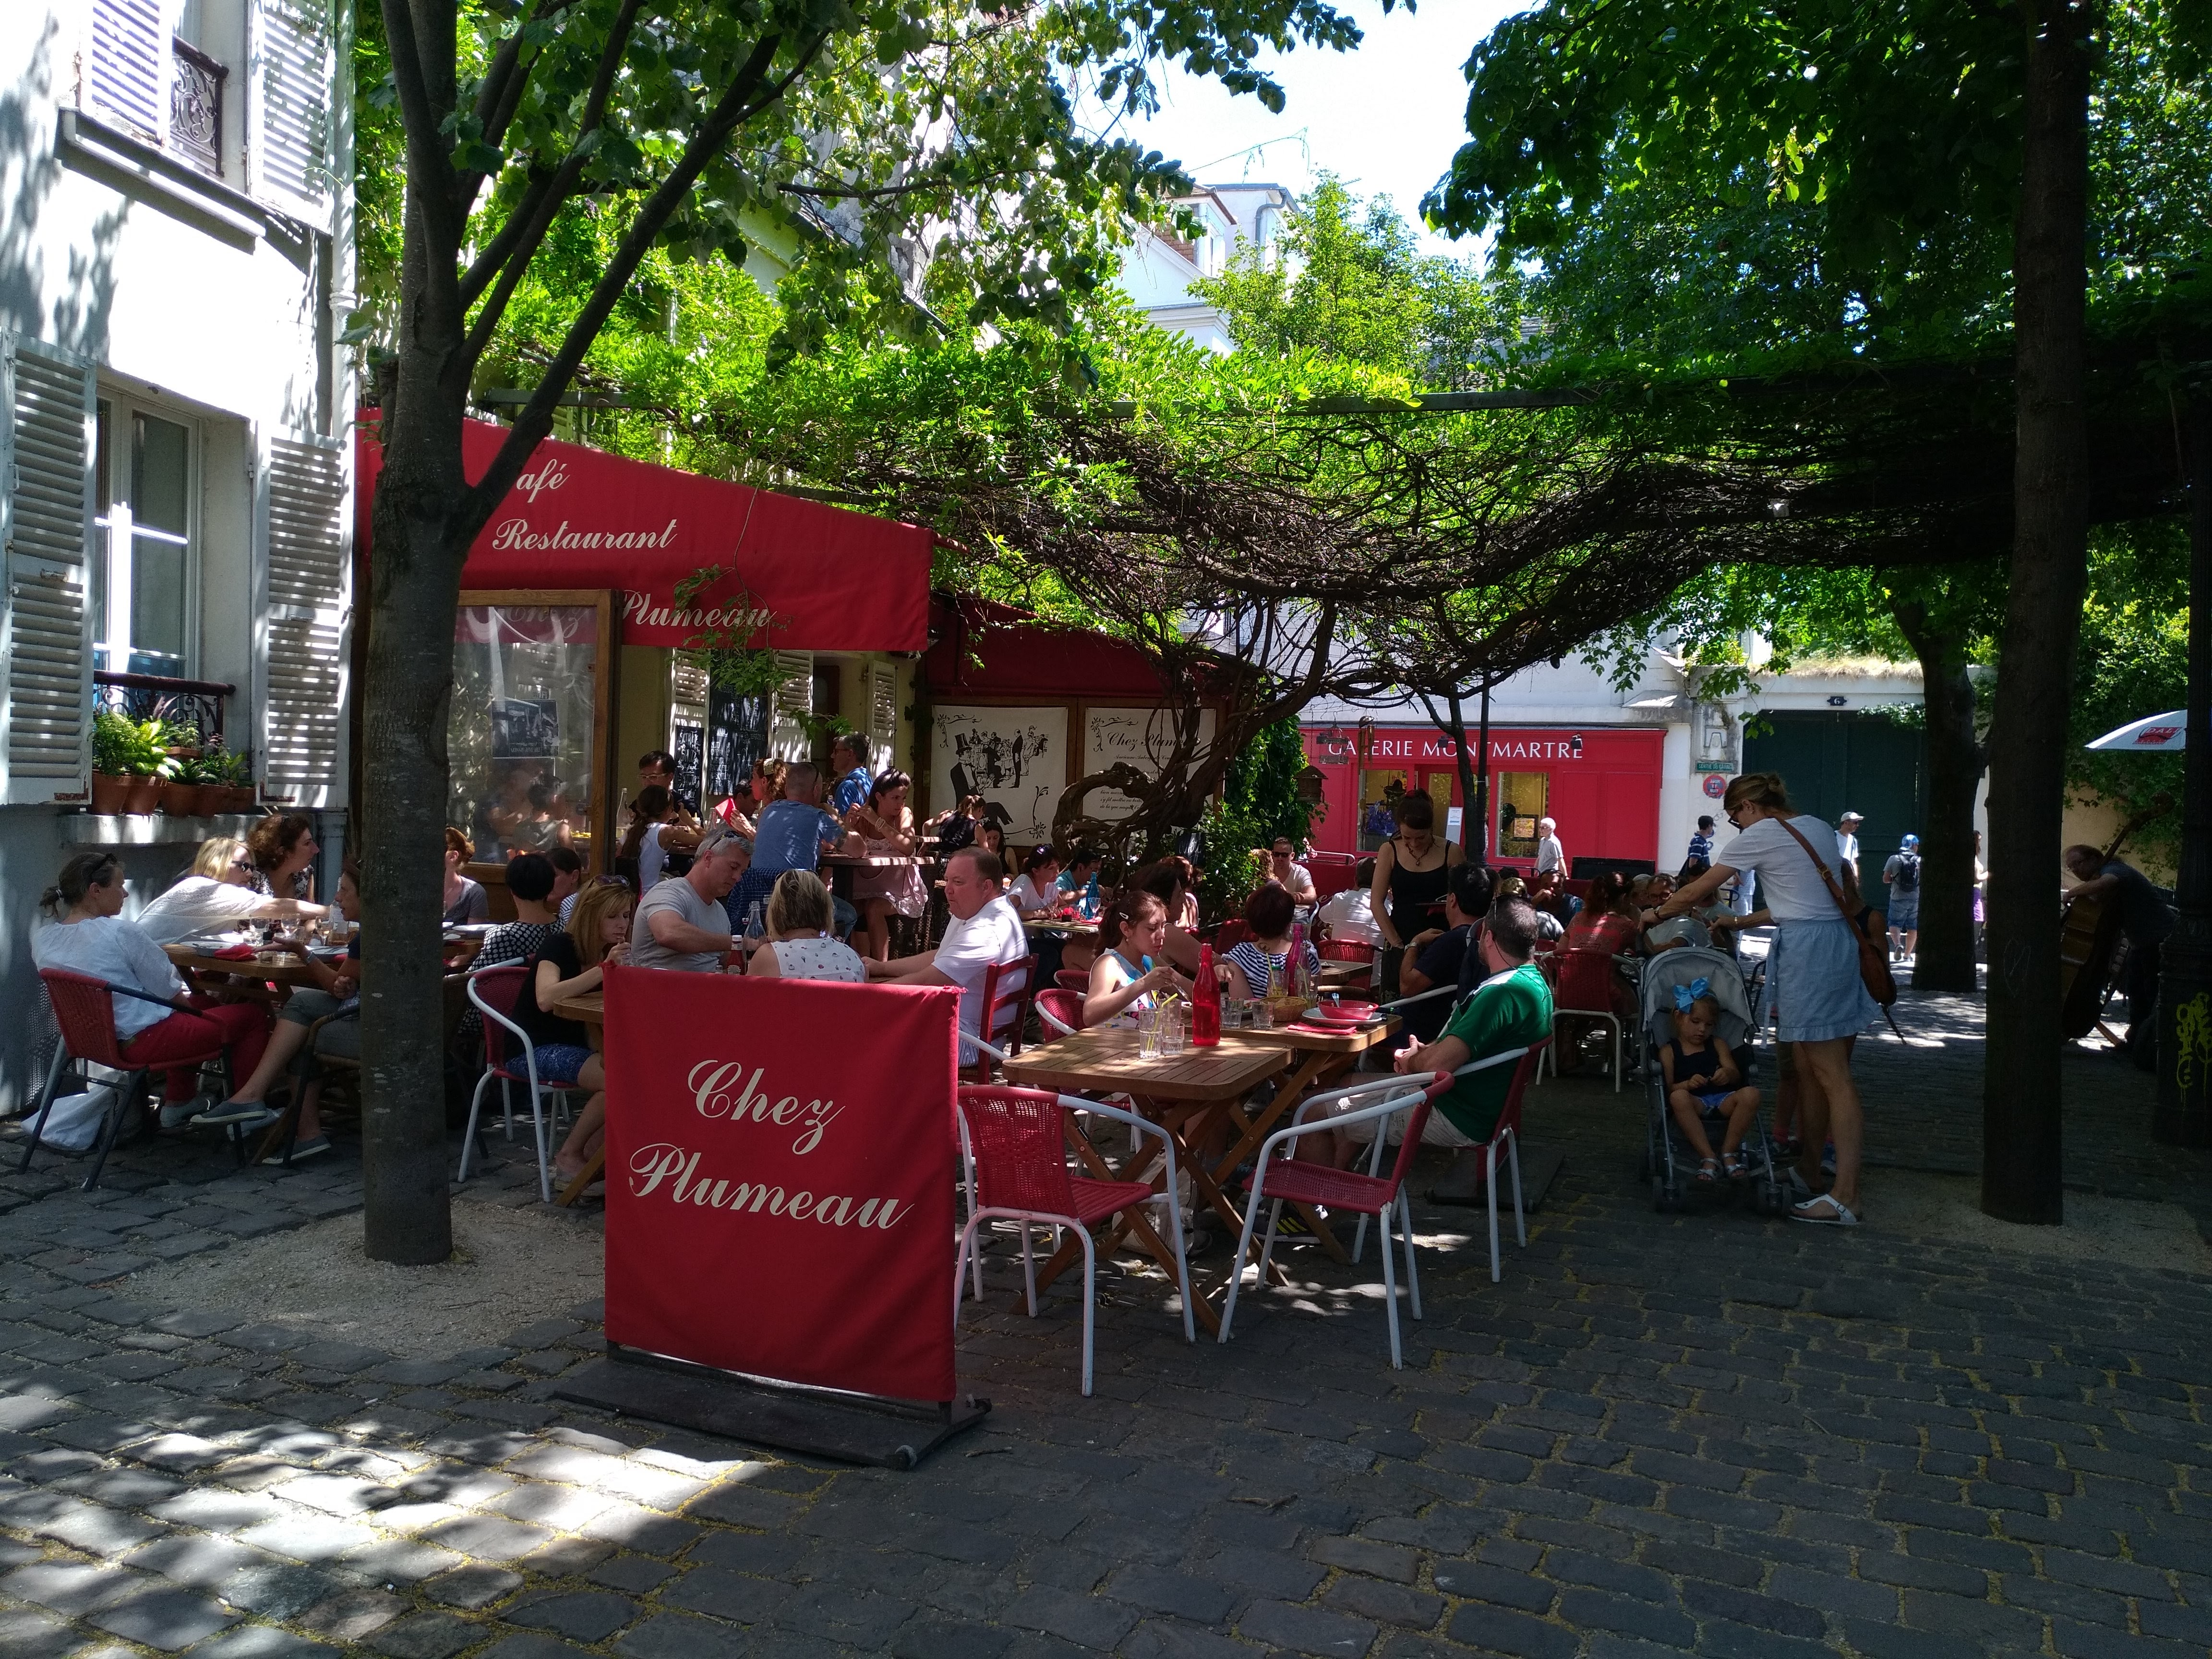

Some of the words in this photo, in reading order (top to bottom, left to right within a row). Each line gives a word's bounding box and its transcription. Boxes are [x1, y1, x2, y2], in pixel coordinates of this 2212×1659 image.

[516, 459, 571, 503] afé
[492, 518, 678, 550] Restaurant
[624, 589, 777, 627] Plumeau
[1107, 732, 1138, 752] Chez
[1329, 740, 1413, 757] GAERIE
[1422, 741, 1583, 758] MONMARTRE
[687, 1059, 846, 1154] Chez
[629, 1142, 915, 1229] Plumeau
